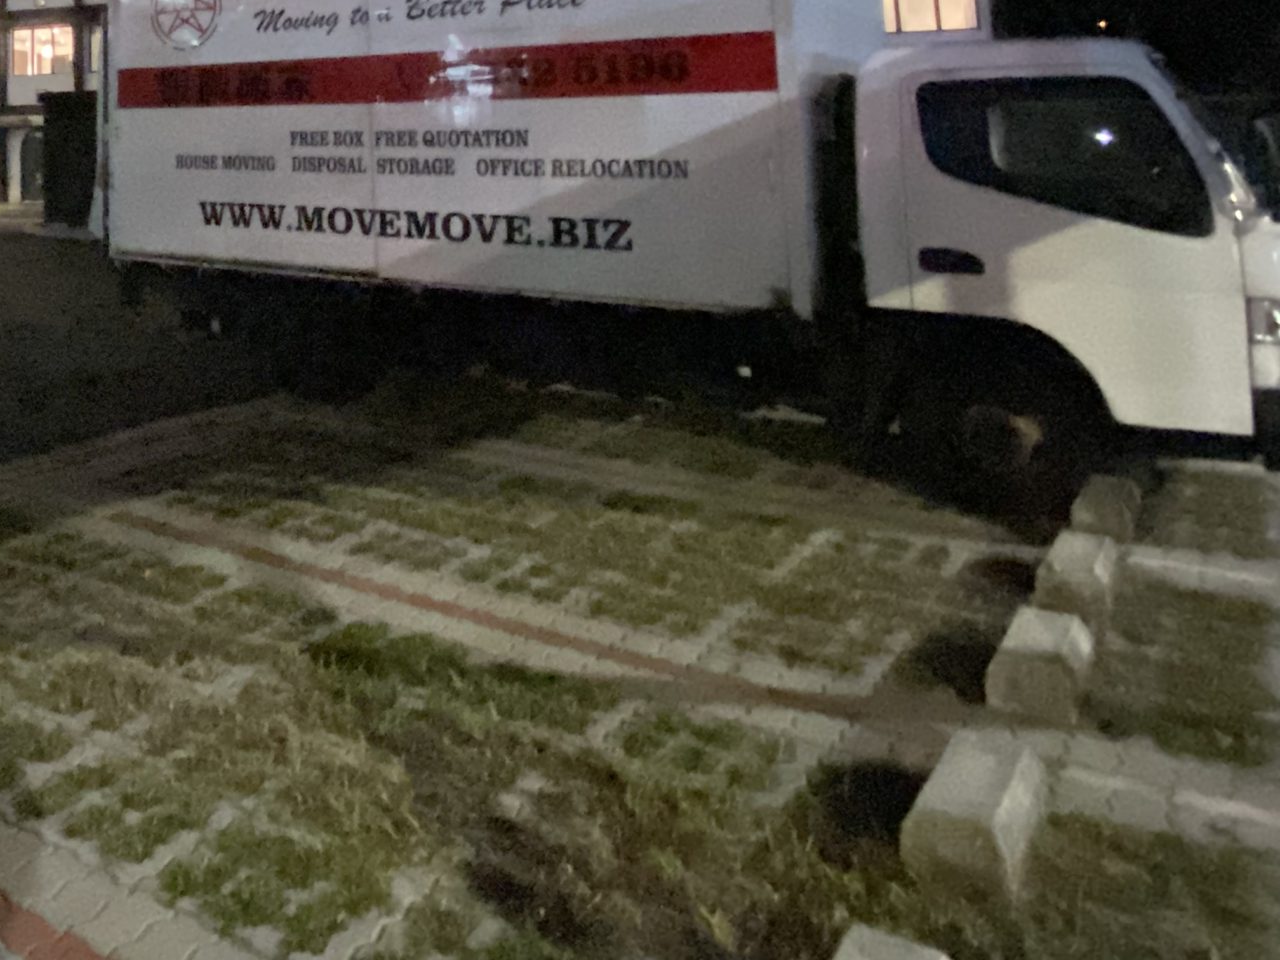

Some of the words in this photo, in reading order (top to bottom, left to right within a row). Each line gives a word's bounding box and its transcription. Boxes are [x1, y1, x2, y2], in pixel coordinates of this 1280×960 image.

[253, 7, 339, 35] Moving
[350, 6, 369, 26] to
[290, 130, 330, 147] FREE
[333, 130, 365, 147] BOX
[375, 130, 417, 147] FREE
[423, 129, 529, 148] QUOTATION
[176, 154, 218, 170] HOUSE
[221, 155, 276, 171] MOVING
[292, 156, 367, 174] DISPOSAL
[376, 157, 455, 176] STORAGE
[476, 158, 546, 177] OFFICE
[551, 159, 689, 179] RELOCATION
[199, 200, 633, 251] WWW.MOVEMOVE.BIZ
